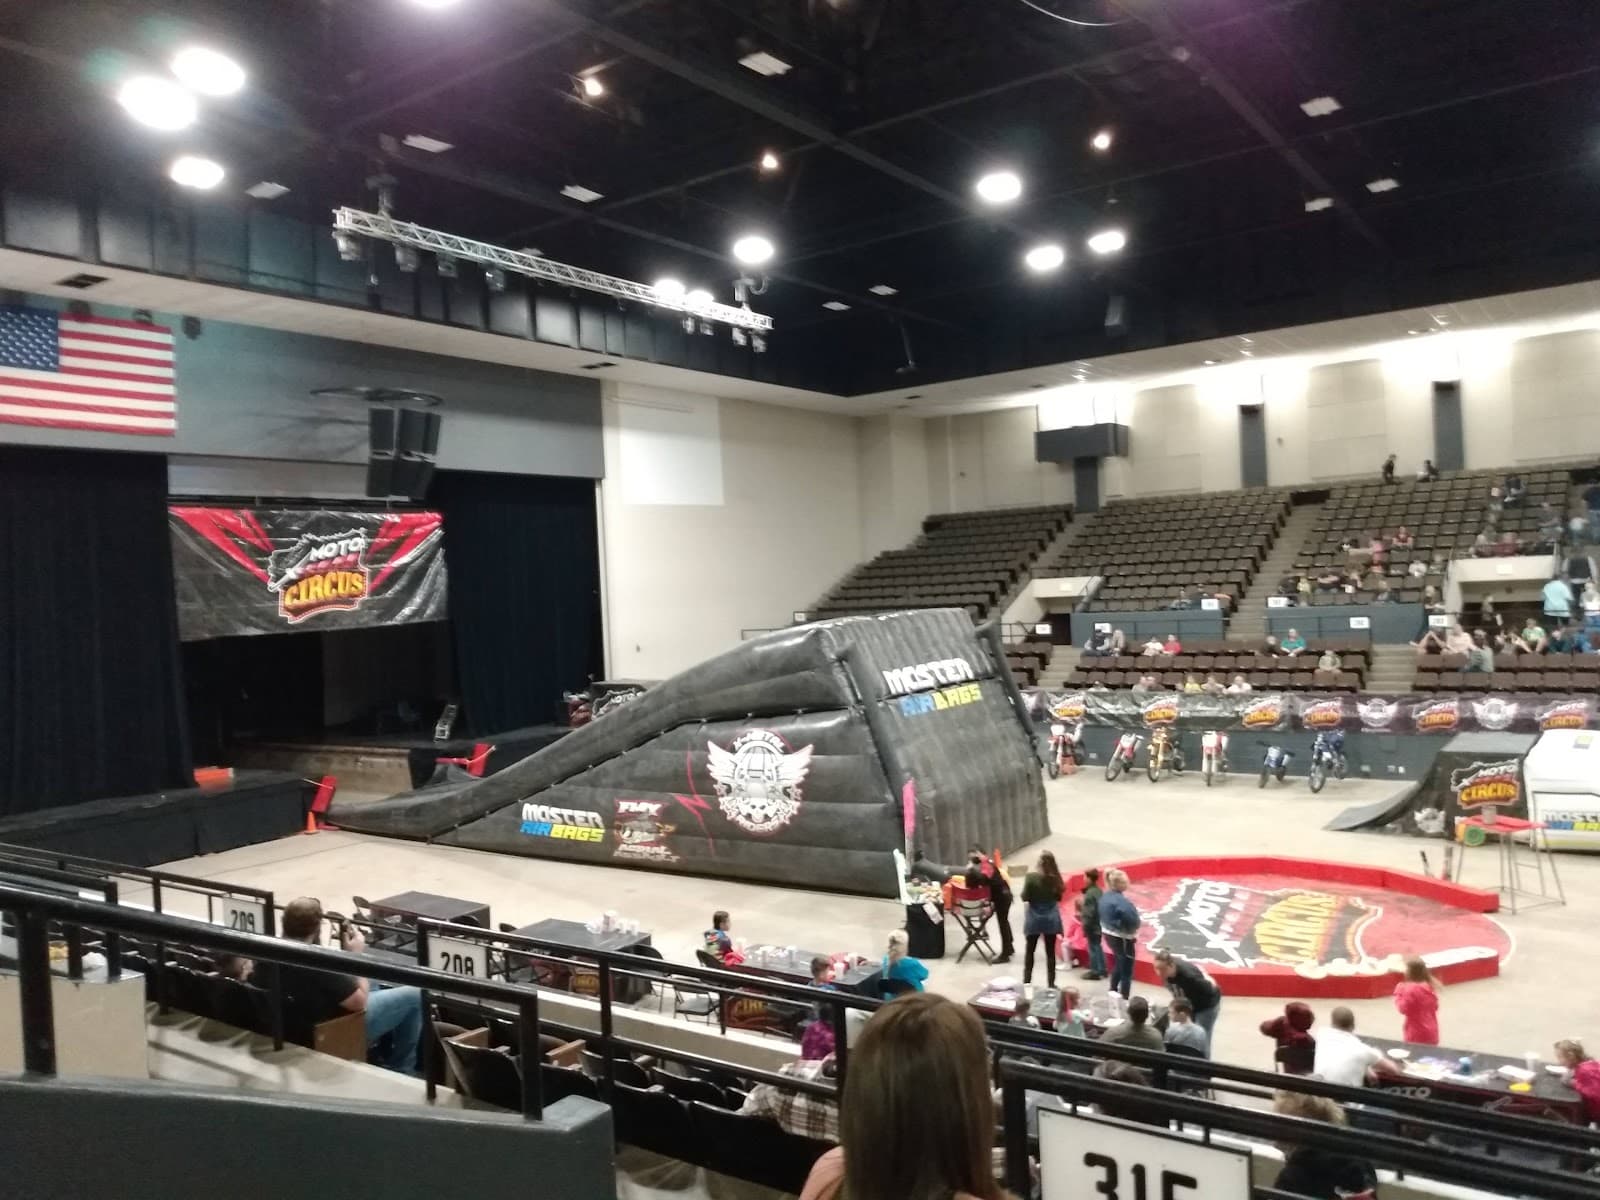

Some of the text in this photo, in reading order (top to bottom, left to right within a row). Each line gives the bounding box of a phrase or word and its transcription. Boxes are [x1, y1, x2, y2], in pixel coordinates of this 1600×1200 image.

[310, 537, 365, 560] MOTO
[284, 571, 364, 609] CIRCUS
[882, 658, 974, 695] MOSTER
[1479, 764, 1519, 777] MOTO
[1461, 781, 1517, 803] CIRCUS
[522, 803, 605, 829] MOSTER
[1186, 881, 1232, 926] MOTO
[231, 910, 255, 931] 209
[1254, 894, 1337, 960] CIRCUS
[441, 952, 474, 976] 208
